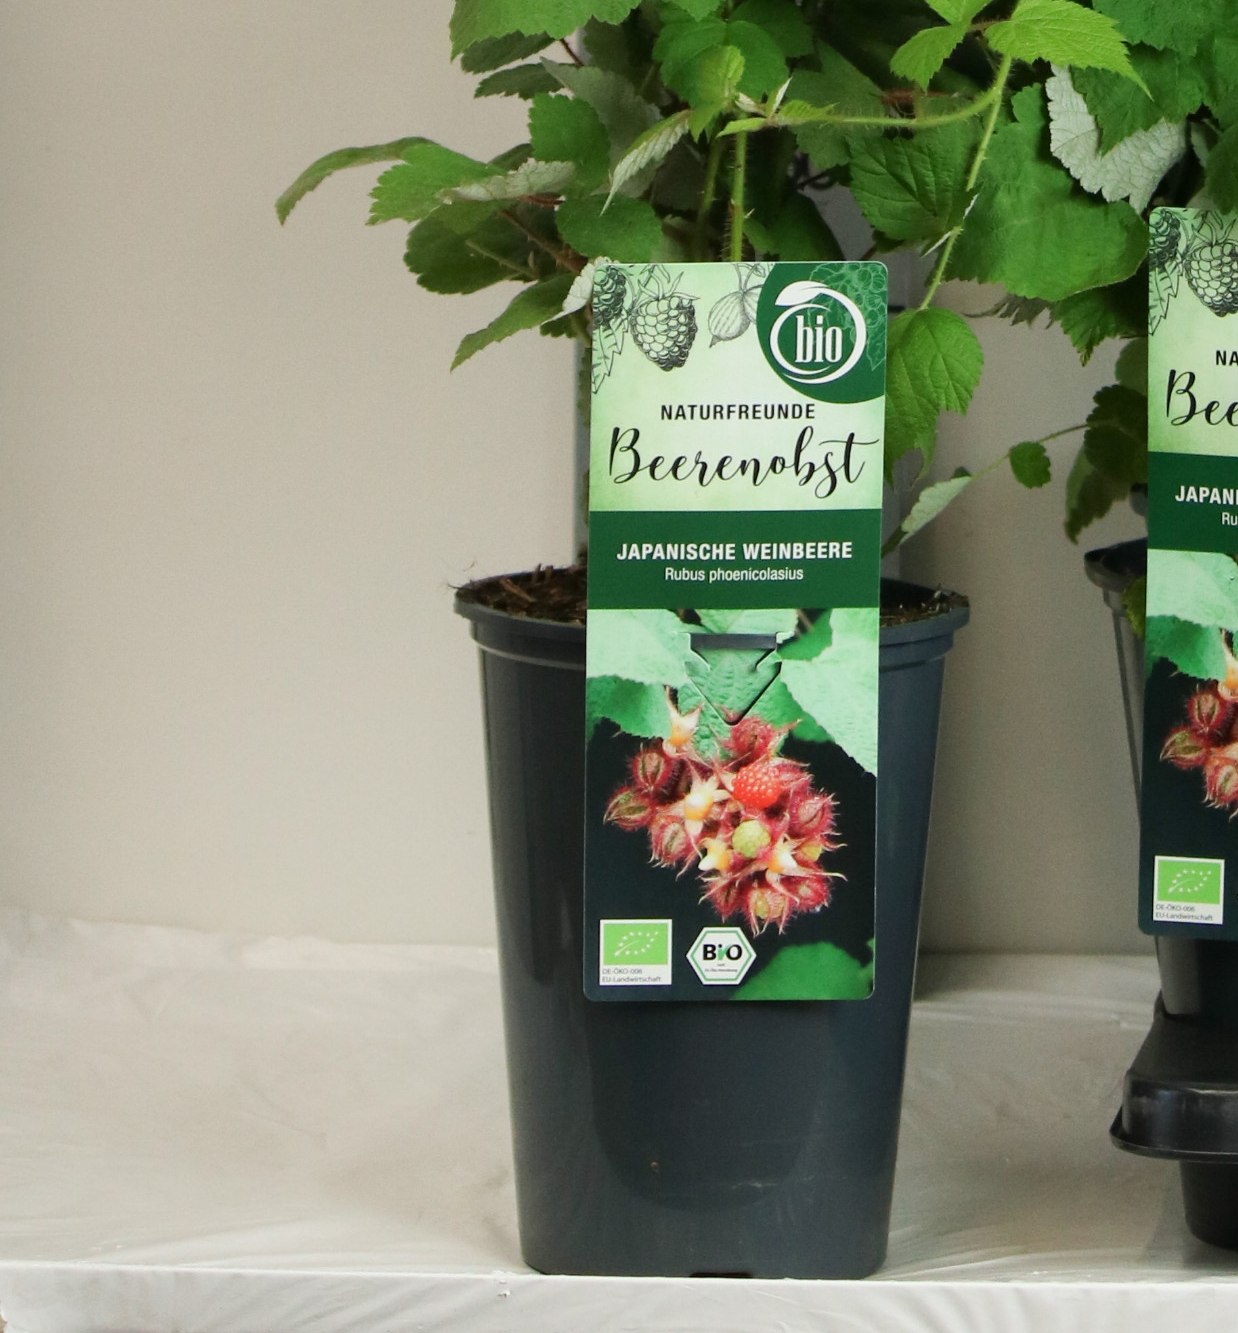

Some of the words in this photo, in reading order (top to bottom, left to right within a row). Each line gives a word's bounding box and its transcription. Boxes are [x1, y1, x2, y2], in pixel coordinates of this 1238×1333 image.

[794, 314, 843, 363] bio
[660, 403, 815, 421] NATURFREUNDE
[609, 425, 880, 499] Beerenobst
[616, 543, 736, 561] JAPANISCHE
[742, 541, 853, 560] WEINBEERE
[665, 566, 706, 581] Rubus
[709, 566, 804, 584] phoenicolasius
